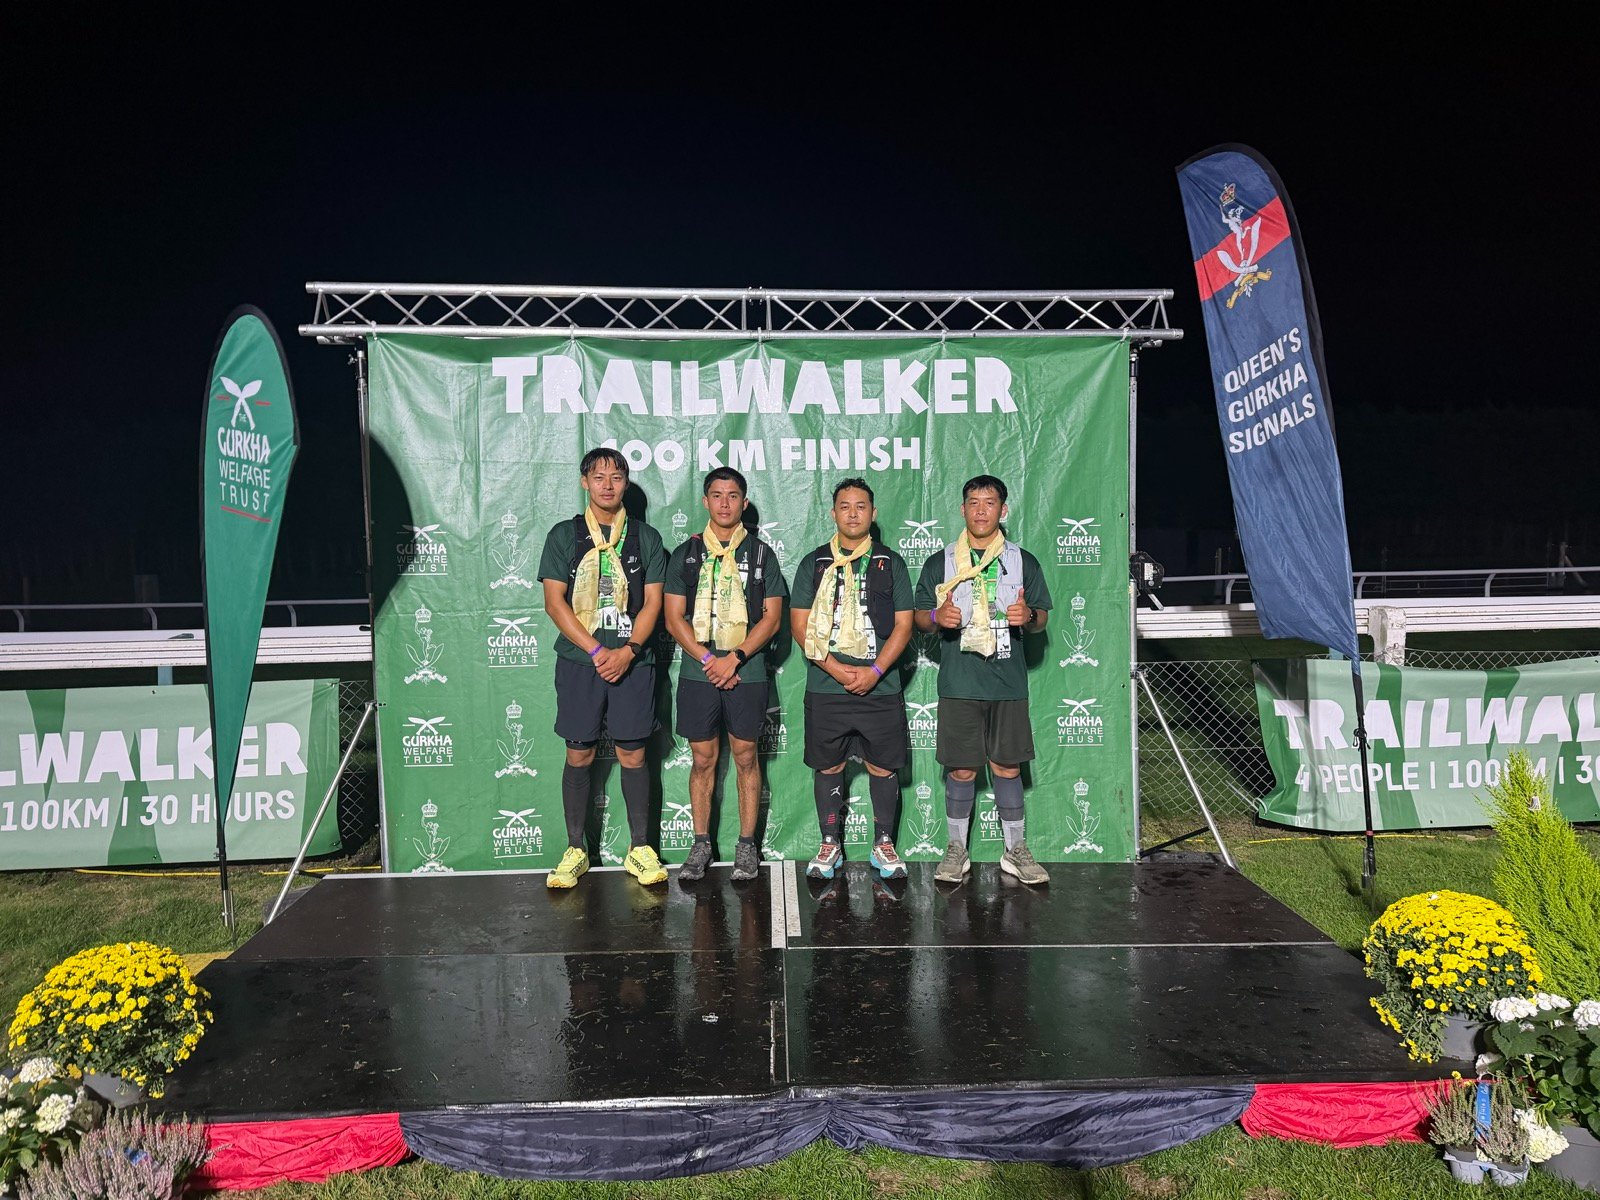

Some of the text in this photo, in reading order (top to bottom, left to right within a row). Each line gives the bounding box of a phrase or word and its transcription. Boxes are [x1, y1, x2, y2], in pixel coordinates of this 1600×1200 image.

[1224, 327, 1302, 393] QUEEN'S
[492, 356, 1019, 416] TRAILWALKER
[1228, 362, 1308, 423] GURKHA
[1229, 393, 1316, 453] SIGNALS
[218, 427, 271, 465] GURKHA
[698, 438, 767, 472] KM
[780, 436, 921, 472] FINISH
[219, 458, 271, 489] WELFARE
[219, 482, 270, 513] TRUST
[898, 537, 945, 549] GURKHA
[1056, 535, 1101, 547] GURKHA
[396, 543, 447, 555] GURKHA
[1056, 546, 1101, 555] WELFARE
[1056, 554, 1101, 563] TRUST
[487, 635, 538, 647] GURKHA
[487, 646, 538, 656] WELFARE
[487, 655, 538, 665] TRUST
[908, 719, 938, 731] URKH
[1056, 715, 1103, 727] GURKHA
[1057, 727, 1104, 735] WELFARE
[402, 734, 453, 747] GURKHA
[910, 738, 938, 747] RUS
[1057, 735, 1104, 744] TRUST
[403, 746, 453, 756] WELFARE
[403, 755, 453, 764] TRUST
[1318, 761, 1420, 794] PEOPLE
[0, 797, 110, 831] 100KM
[140, 794, 179, 826] 30
[492, 825, 542, 839] GURKHA
[660, 831, 694, 839] WELFA
[493, 836, 543, 847] WELFARE
[493, 844, 543, 855] TRUST
